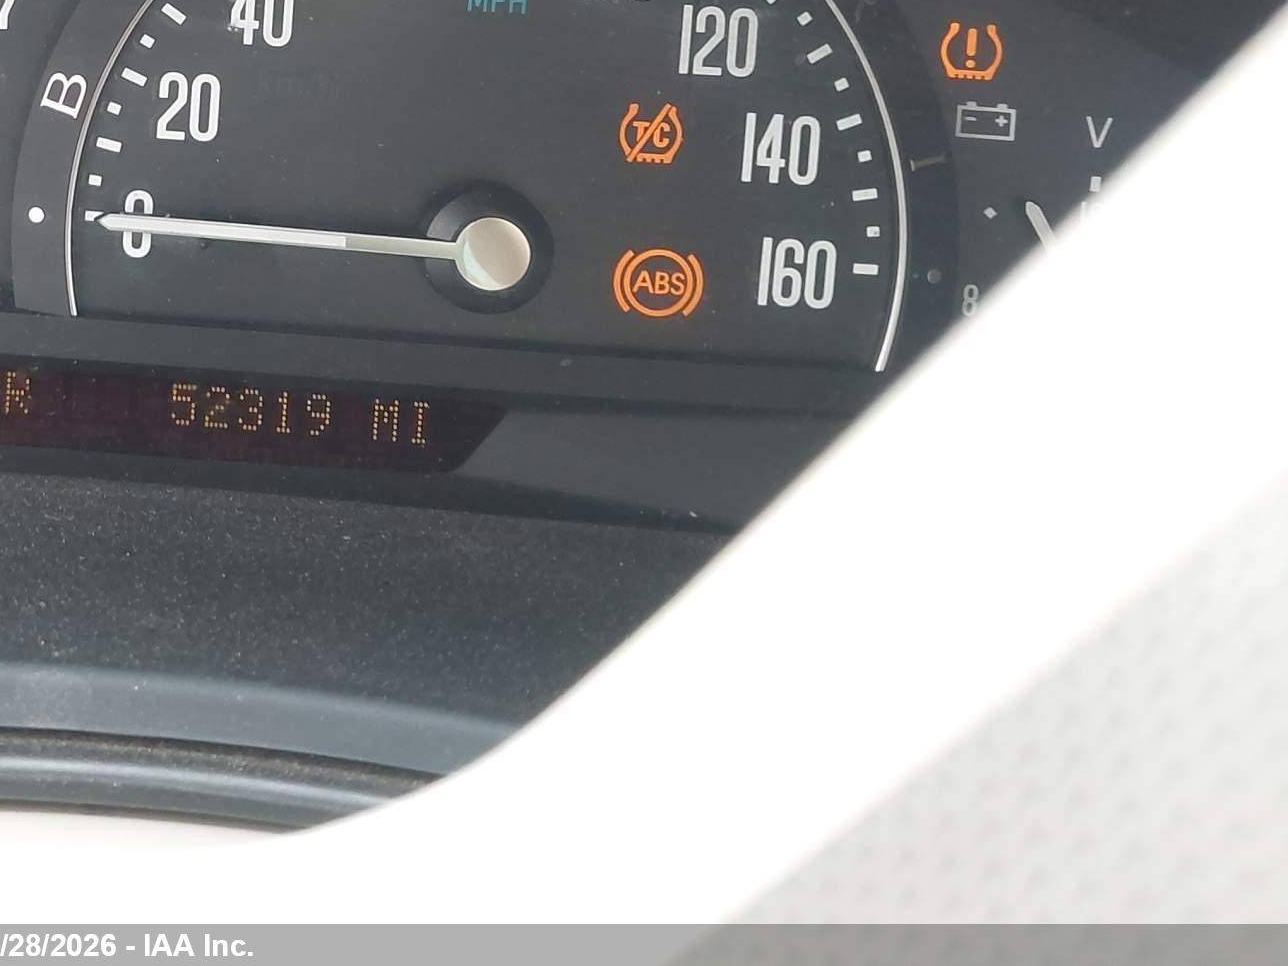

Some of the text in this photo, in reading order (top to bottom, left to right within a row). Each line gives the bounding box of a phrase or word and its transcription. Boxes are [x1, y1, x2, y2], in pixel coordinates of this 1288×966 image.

[678, 4, 758, 78] 120
[156, 71, 221, 142] 20
[1086, 116, 1113, 148] V
[741, 112, 821, 186] 140
[122, 190, 154, 258] 0
[632, 270, 686, 296] ABS
[757, 237, 837, 309] 160
[170, 383, 332, 436] 52319
[372, 397, 430, 444] MI
